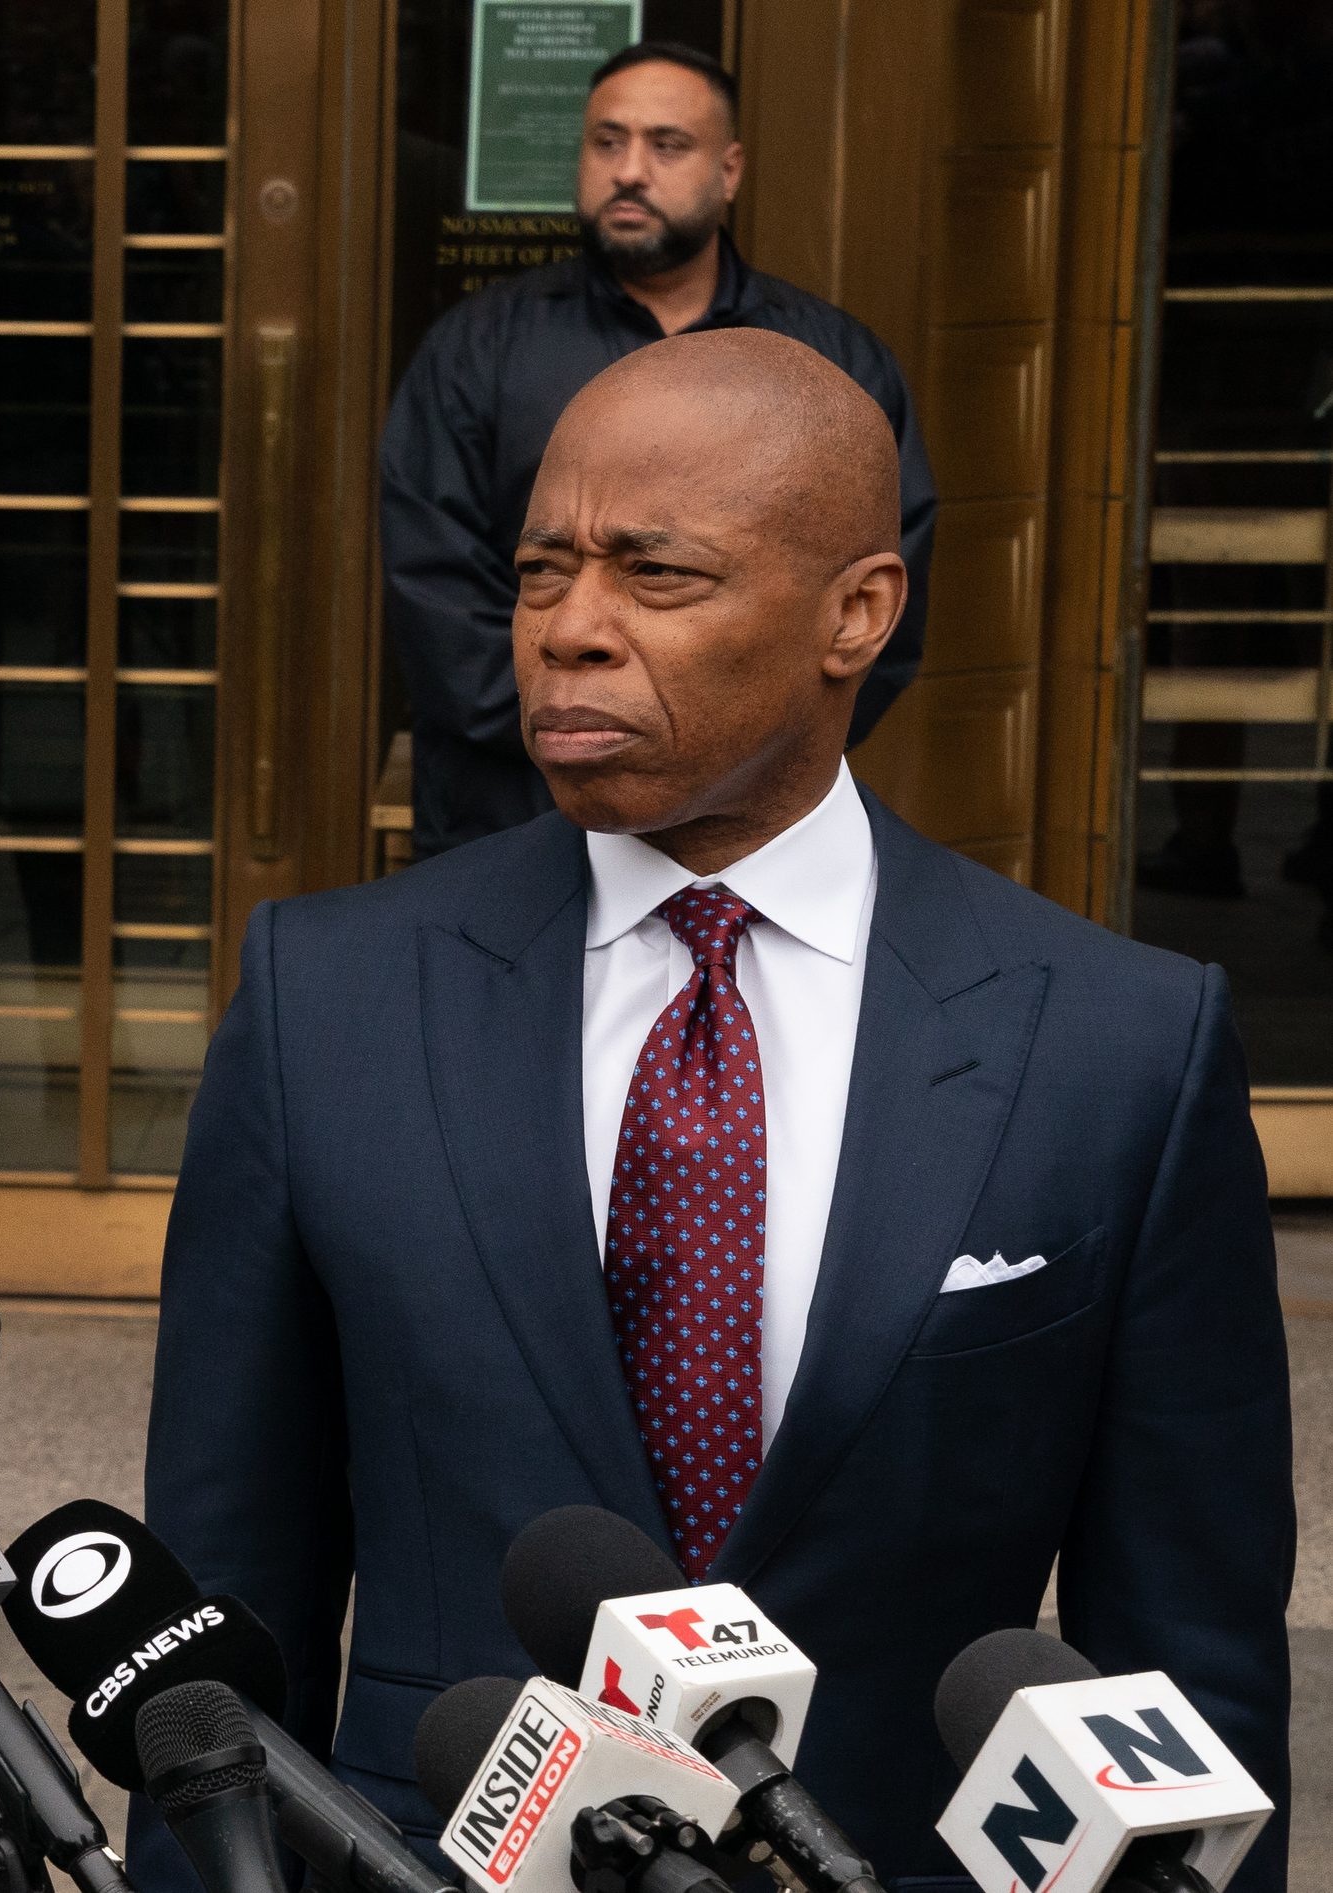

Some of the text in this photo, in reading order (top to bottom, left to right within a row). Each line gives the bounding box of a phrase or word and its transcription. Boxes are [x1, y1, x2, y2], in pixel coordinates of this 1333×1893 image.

[477, 216, 582, 236] SMOKING
[462, 245, 513, 266] FEET
[671, 1643, 789, 1669] TELEMUNDO
[711, 1619, 759, 1645] 47
[85, 1605, 226, 1718] CBS NEWS
[1080, 1707, 1212, 1784] N
[459, 1705, 559, 1859] INSIDE
[494, 1738, 579, 1879] EDITION
